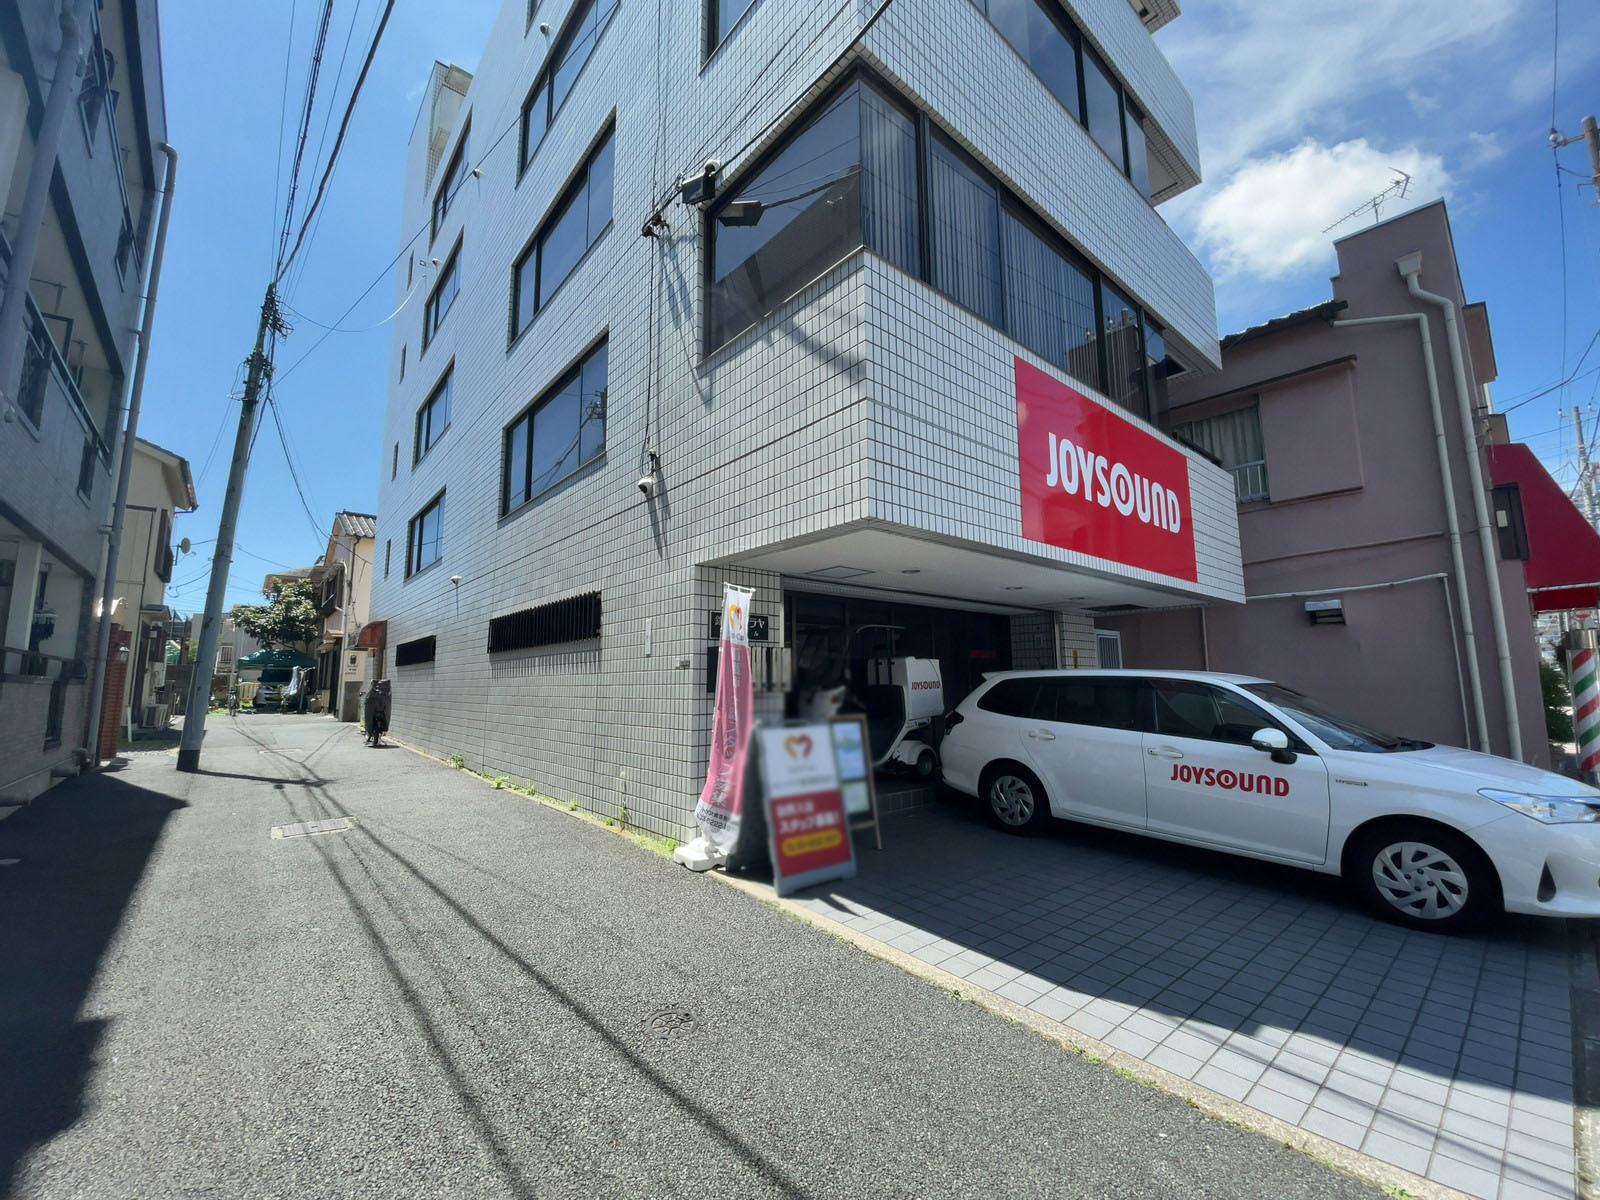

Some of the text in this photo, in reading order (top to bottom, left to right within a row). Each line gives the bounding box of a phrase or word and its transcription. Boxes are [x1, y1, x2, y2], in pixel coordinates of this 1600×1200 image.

[1046, 432, 1181, 533] JOYSOUND
[911, 681, 941, 690] JOYSOUND
[1170, 764, 1290, 797] JOYSOUND
